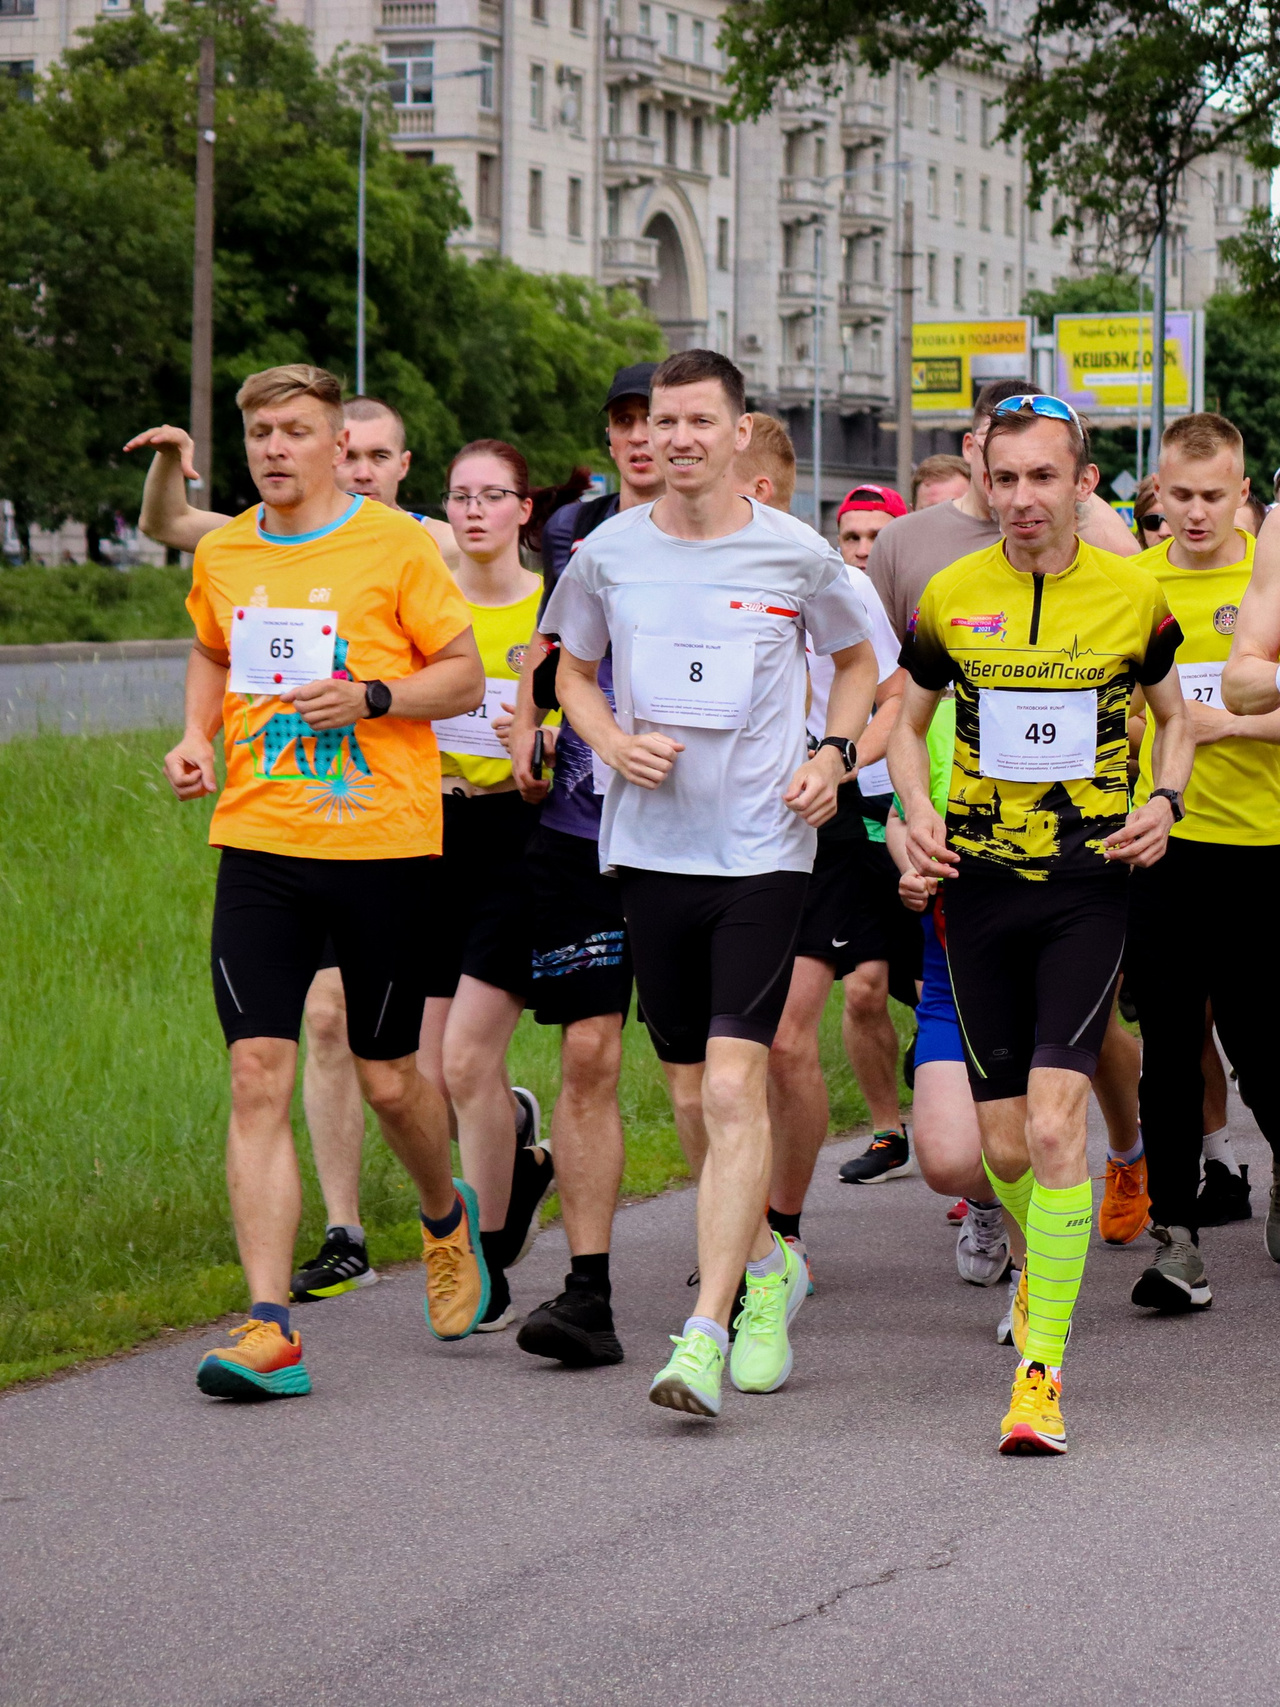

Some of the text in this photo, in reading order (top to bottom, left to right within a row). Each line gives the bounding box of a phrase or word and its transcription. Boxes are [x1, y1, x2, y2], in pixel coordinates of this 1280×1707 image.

[914, 335, 955, 346] УХОВКА
[1073, 351, 1129, 368] КЕШБЭК
[270, 638, 294, 659] 65
[689, 661, 703, 683] 8
[963, 659, 1105, 680] #БеговойПсков
[1193, 687, 1213, 702] 27
[1025, 723, 1056, 744] 49
